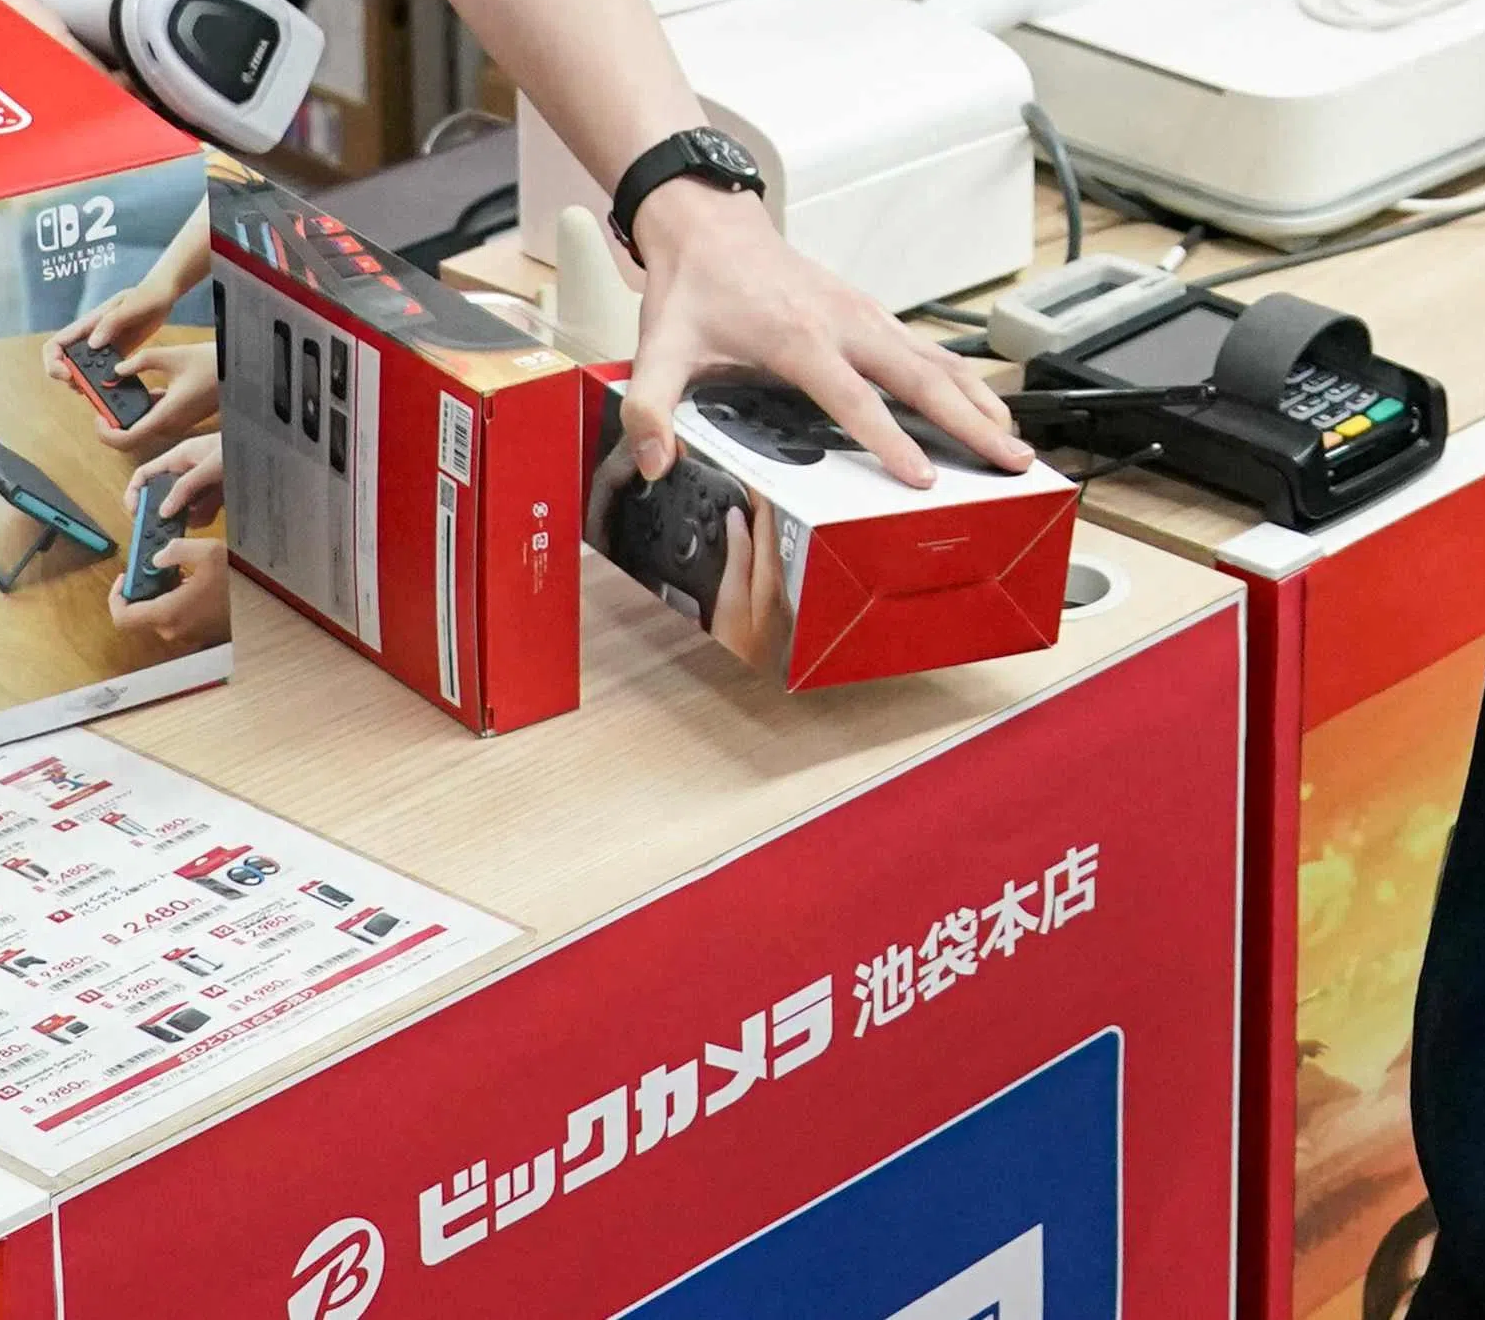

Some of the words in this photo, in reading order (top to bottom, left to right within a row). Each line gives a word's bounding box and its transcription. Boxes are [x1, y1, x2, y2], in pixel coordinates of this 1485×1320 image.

[42, 242, 116, 267] NINTENDO
[43, 252, 116, 282] SWITCH
[418, 974, 834, 1267] ビックカメラ
[852, 842, 1101, 1039] 池袋本店
